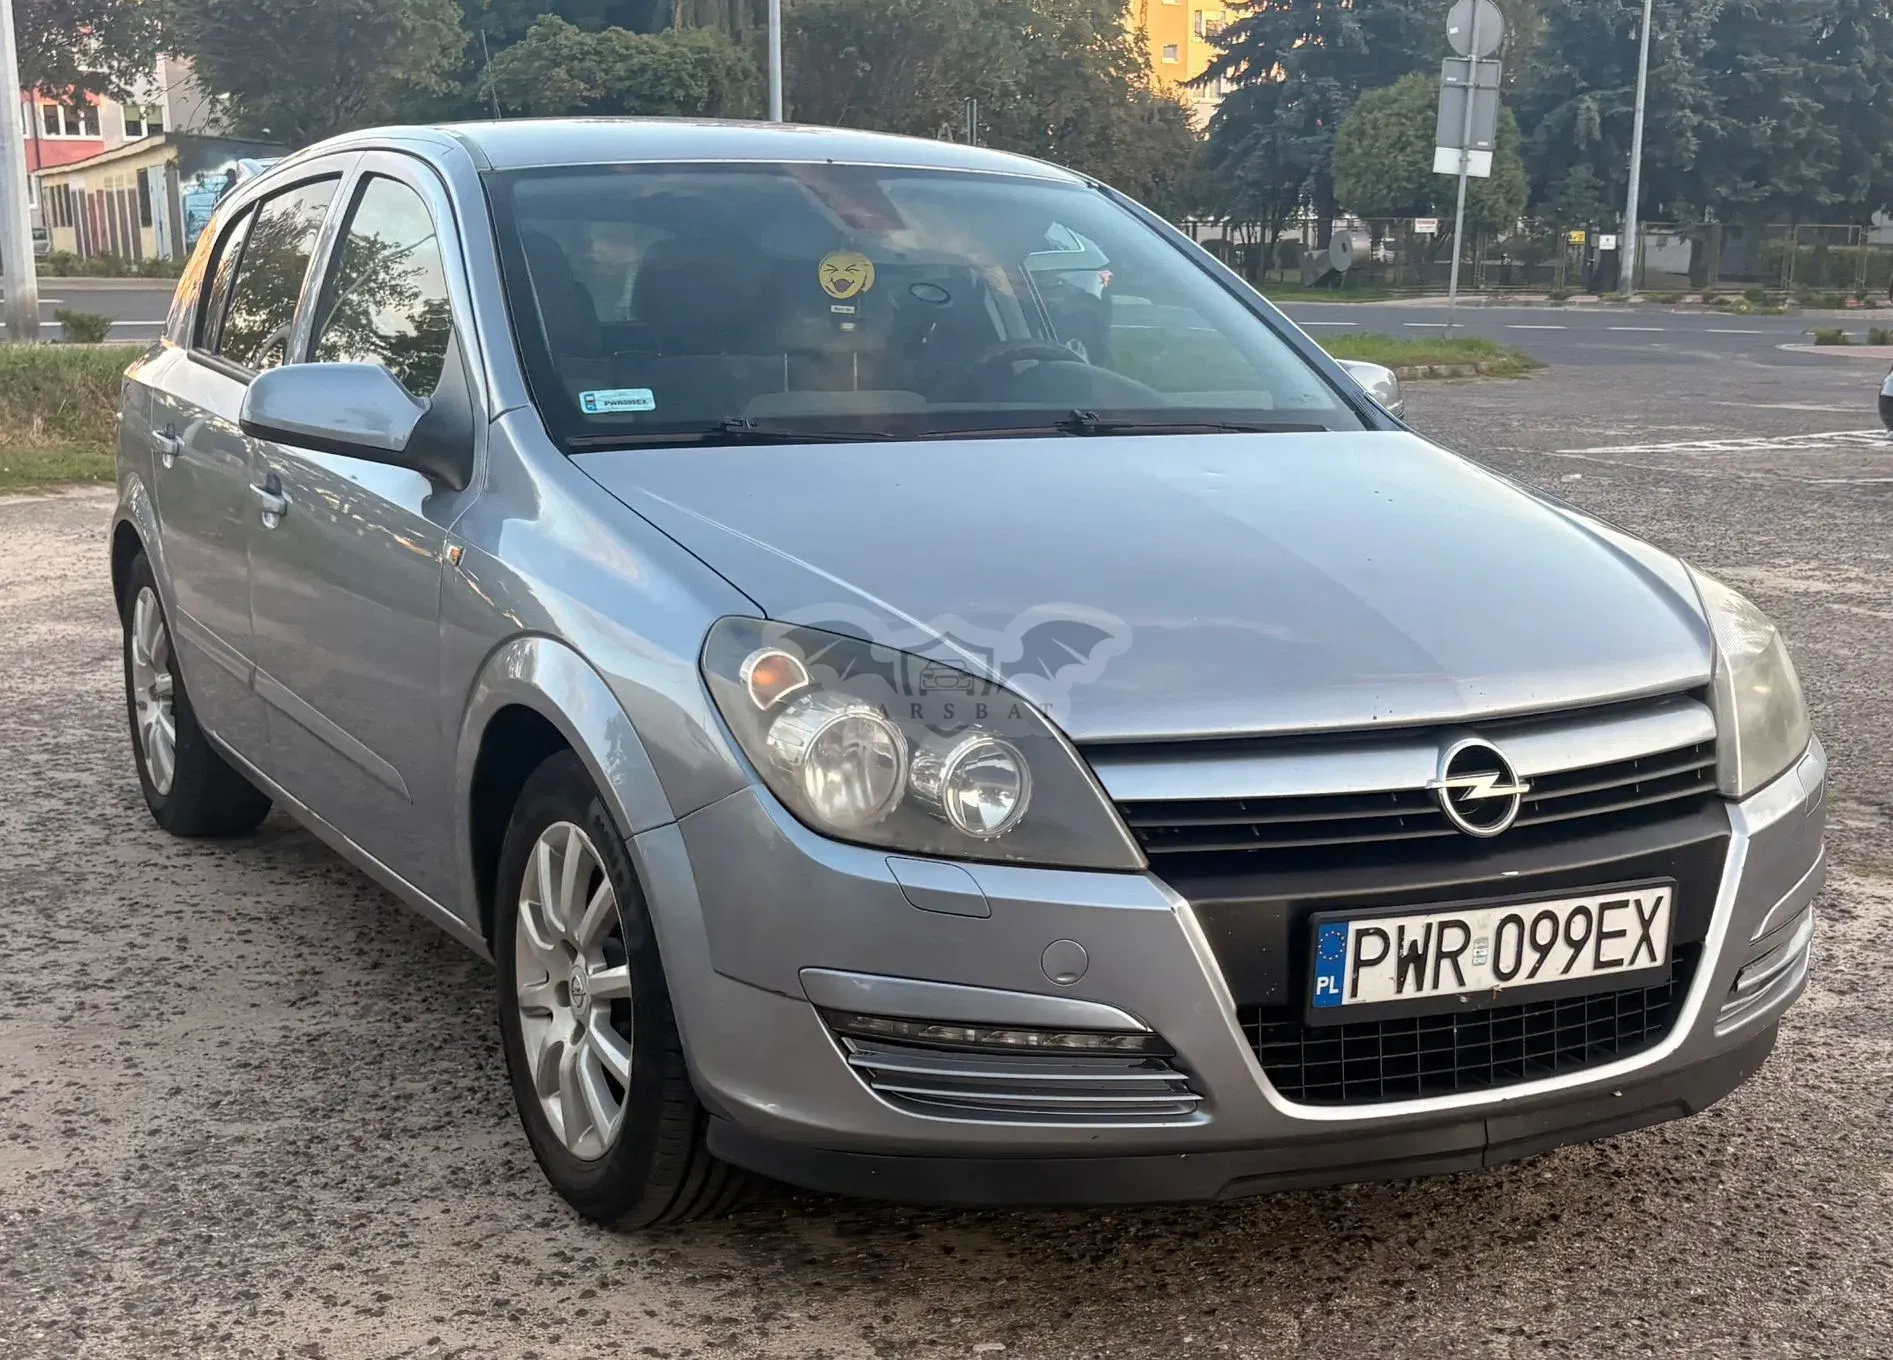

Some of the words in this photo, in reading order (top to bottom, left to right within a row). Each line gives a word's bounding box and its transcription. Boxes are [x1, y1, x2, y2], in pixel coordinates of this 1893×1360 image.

[1350, 919, 1472, 998] PWR
[1493, 896, 1665, 982] 099EX
[1315, 975, 1339, 995] PL
